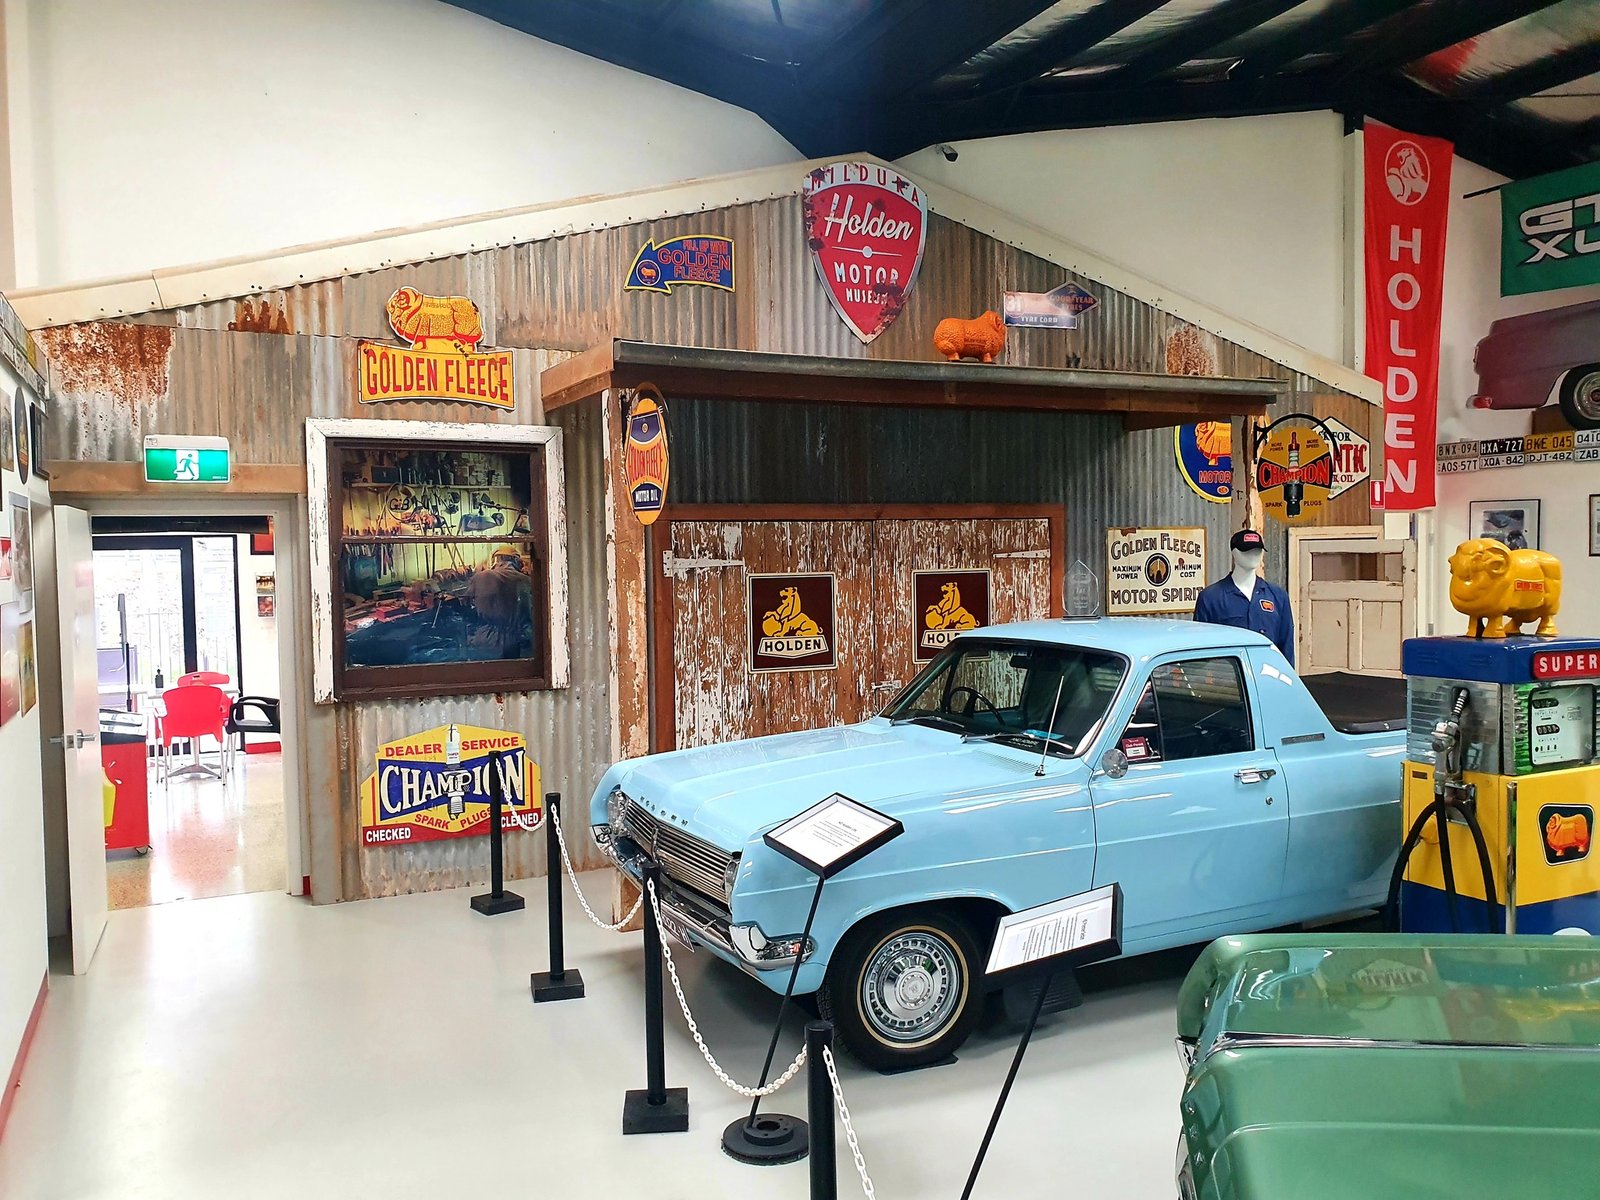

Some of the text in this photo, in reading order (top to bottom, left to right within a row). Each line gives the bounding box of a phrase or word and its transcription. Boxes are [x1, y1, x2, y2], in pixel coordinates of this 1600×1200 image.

[806, 164, 921, 206] MILDURA
[824, 193, 914, 243] Holden
[657, 248, 731, 271] GOLDEN
[674, 265, 721, 283] FLEECE
[834, 261, 899, 285] MOTOR
[1385, 224, 1423, 494] HOLDEN
[366, 349, 509, 401] GOLDEN FLEECE
[1199, 470, 1232, 484] MOTOR
[1260, 456, 1331, 488] CHAMPION
[1340, 474, 1356, 483] OIL
[1111, 532, 1202, 561] GOLDEN FLEECE
[1112, 563, 1202, 573] MAXIMUM MINIMUM
[1116, 572, 1138, 580] POWER
[1111, 588, 1158, 604] MOTOR
[764, 638, 822, 652] HOLDEN
[927, 632, 960, 645] HOL
[1539, 653, 1598, 673] SUPER
[385, 743, 442, 757] DEALER
[461, 736, 519, 751] SERVICE
[414, 806, 492, 830] SPARK PLUGS
[365, 827, 411, 843] CHECKED
